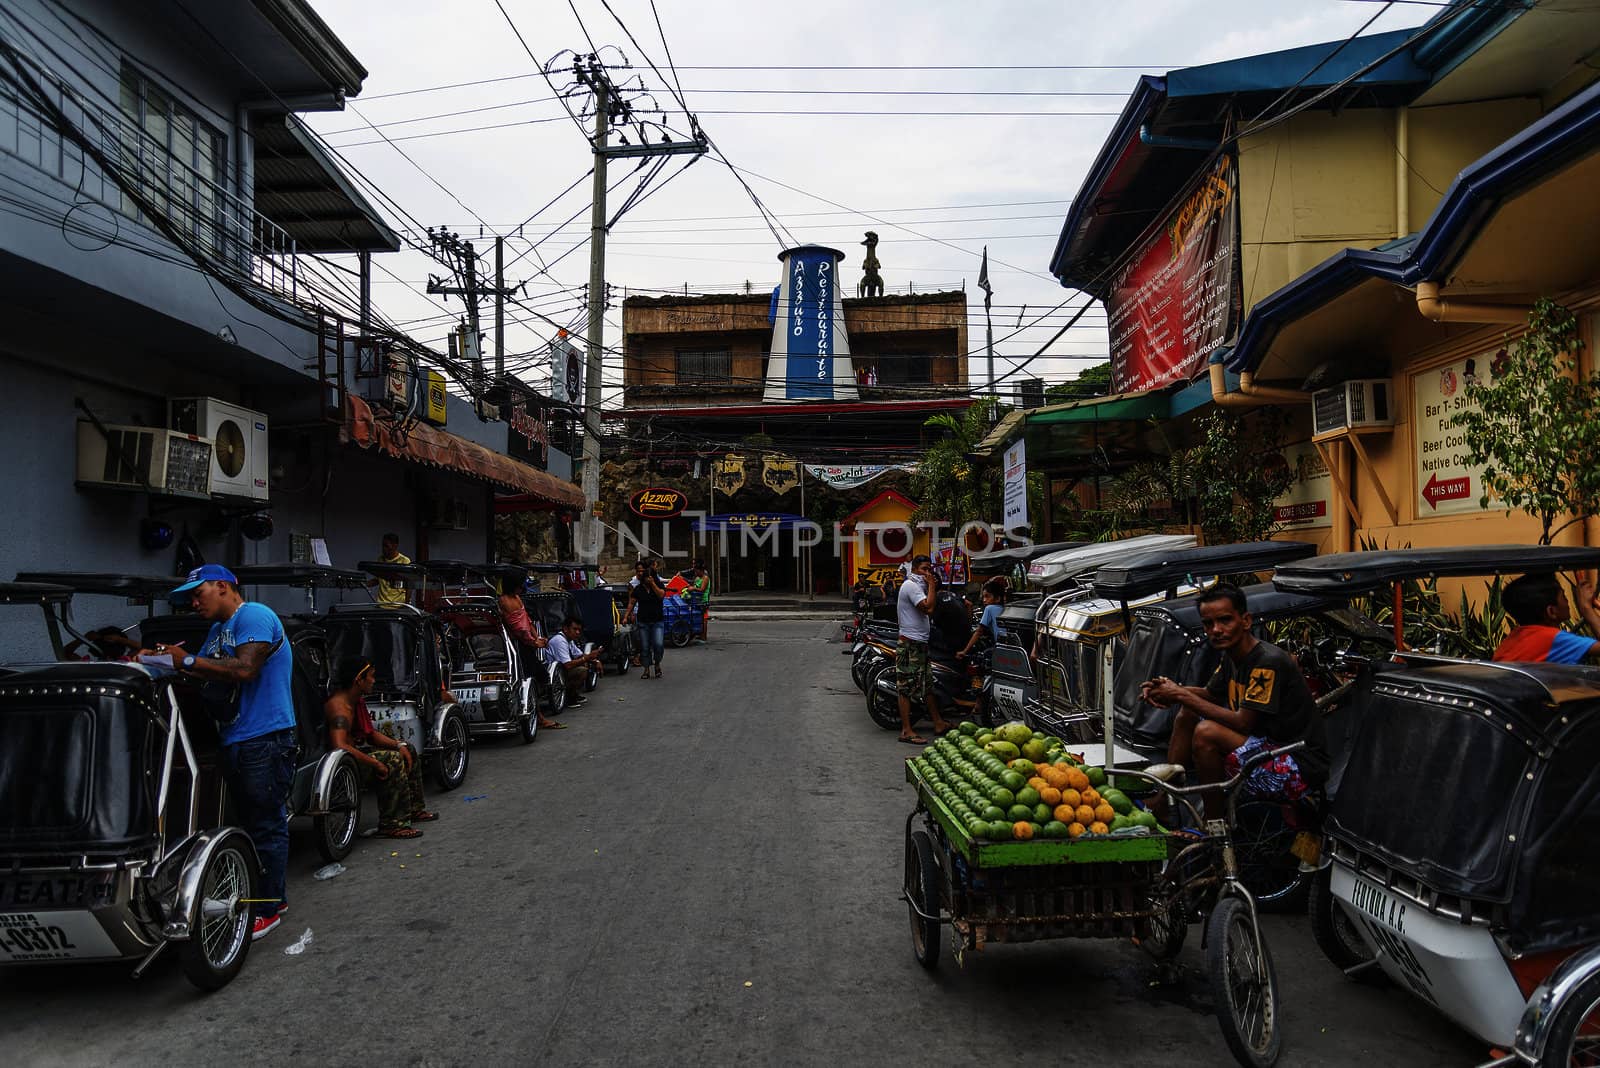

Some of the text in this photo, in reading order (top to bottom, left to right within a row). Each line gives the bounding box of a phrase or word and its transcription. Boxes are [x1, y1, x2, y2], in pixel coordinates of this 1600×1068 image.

[1425, 404, 1441, 418] Bar
[1443, 401, 1452, 413] T-
[1454, 395, 1480, 410] Shirt
[1423, 440, 1443, 453] Beer
[827, 467, 842, 475] Club
[1422, 456, 1451, 473] Native
[1430, 483, 1465, 497] THIS WAY!
